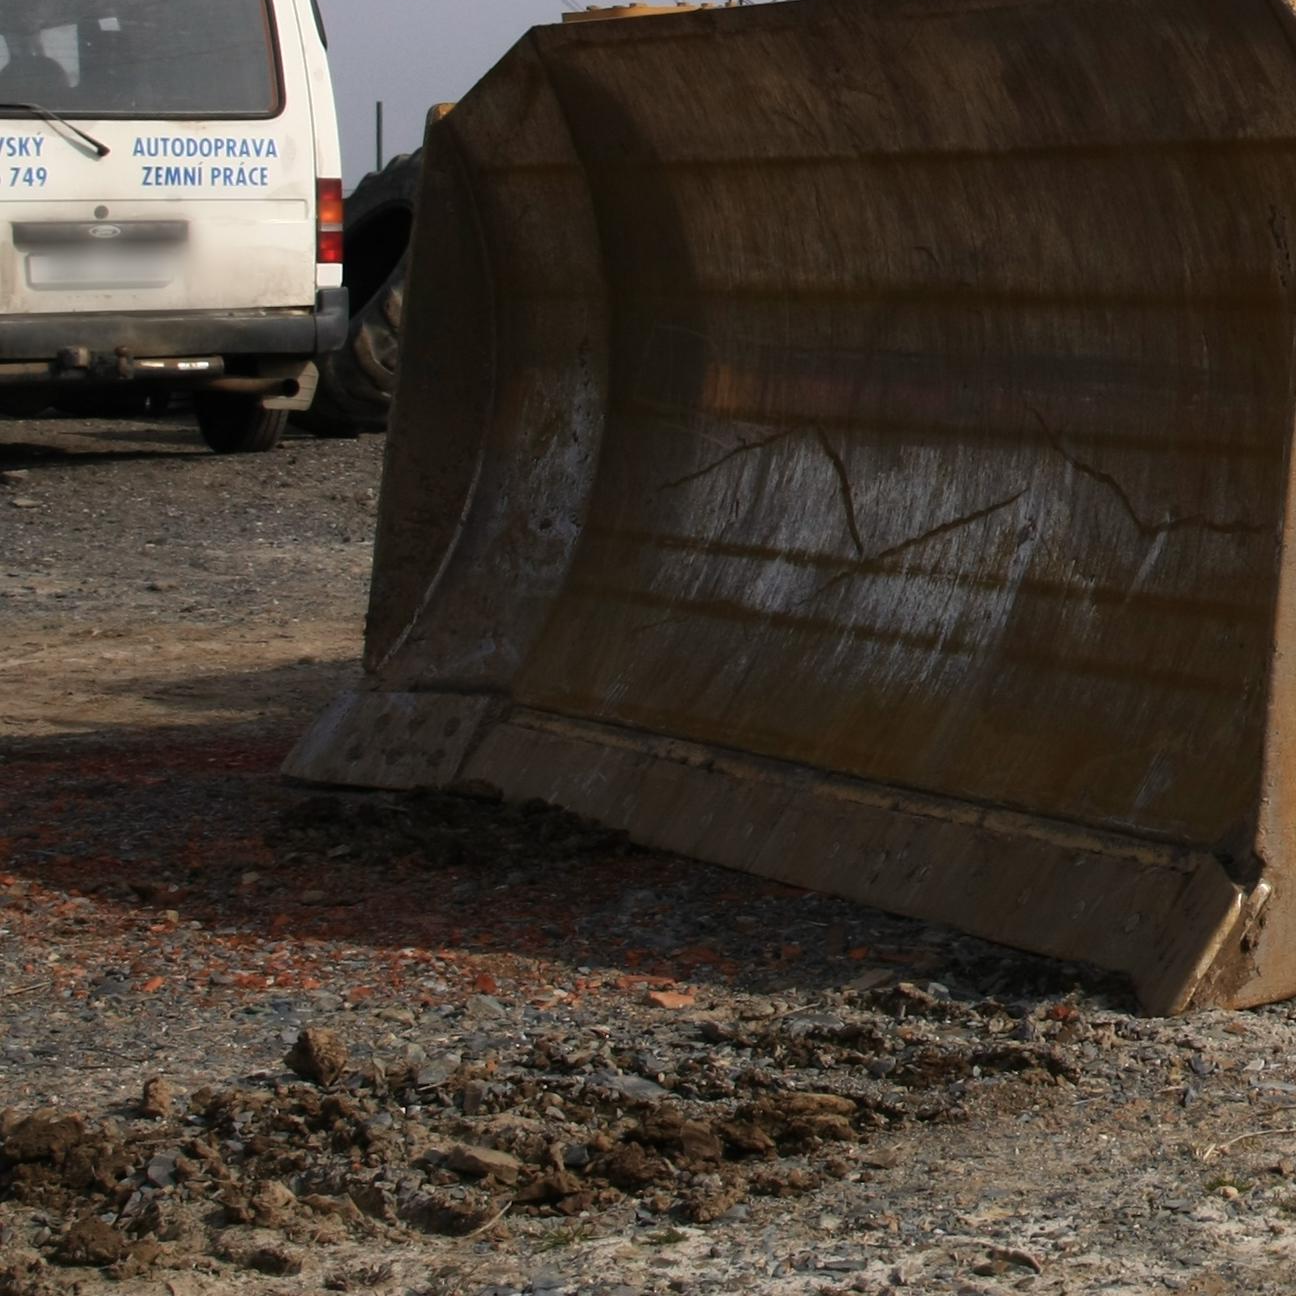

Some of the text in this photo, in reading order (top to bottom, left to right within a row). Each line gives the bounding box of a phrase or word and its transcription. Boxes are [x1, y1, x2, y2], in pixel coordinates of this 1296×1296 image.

[132, 136, 278, 158] AUTODOPRAVA
[9, 166, 48, 187] 749
[141, 161, 269, 186] ZEMNÍ PRÁCE
